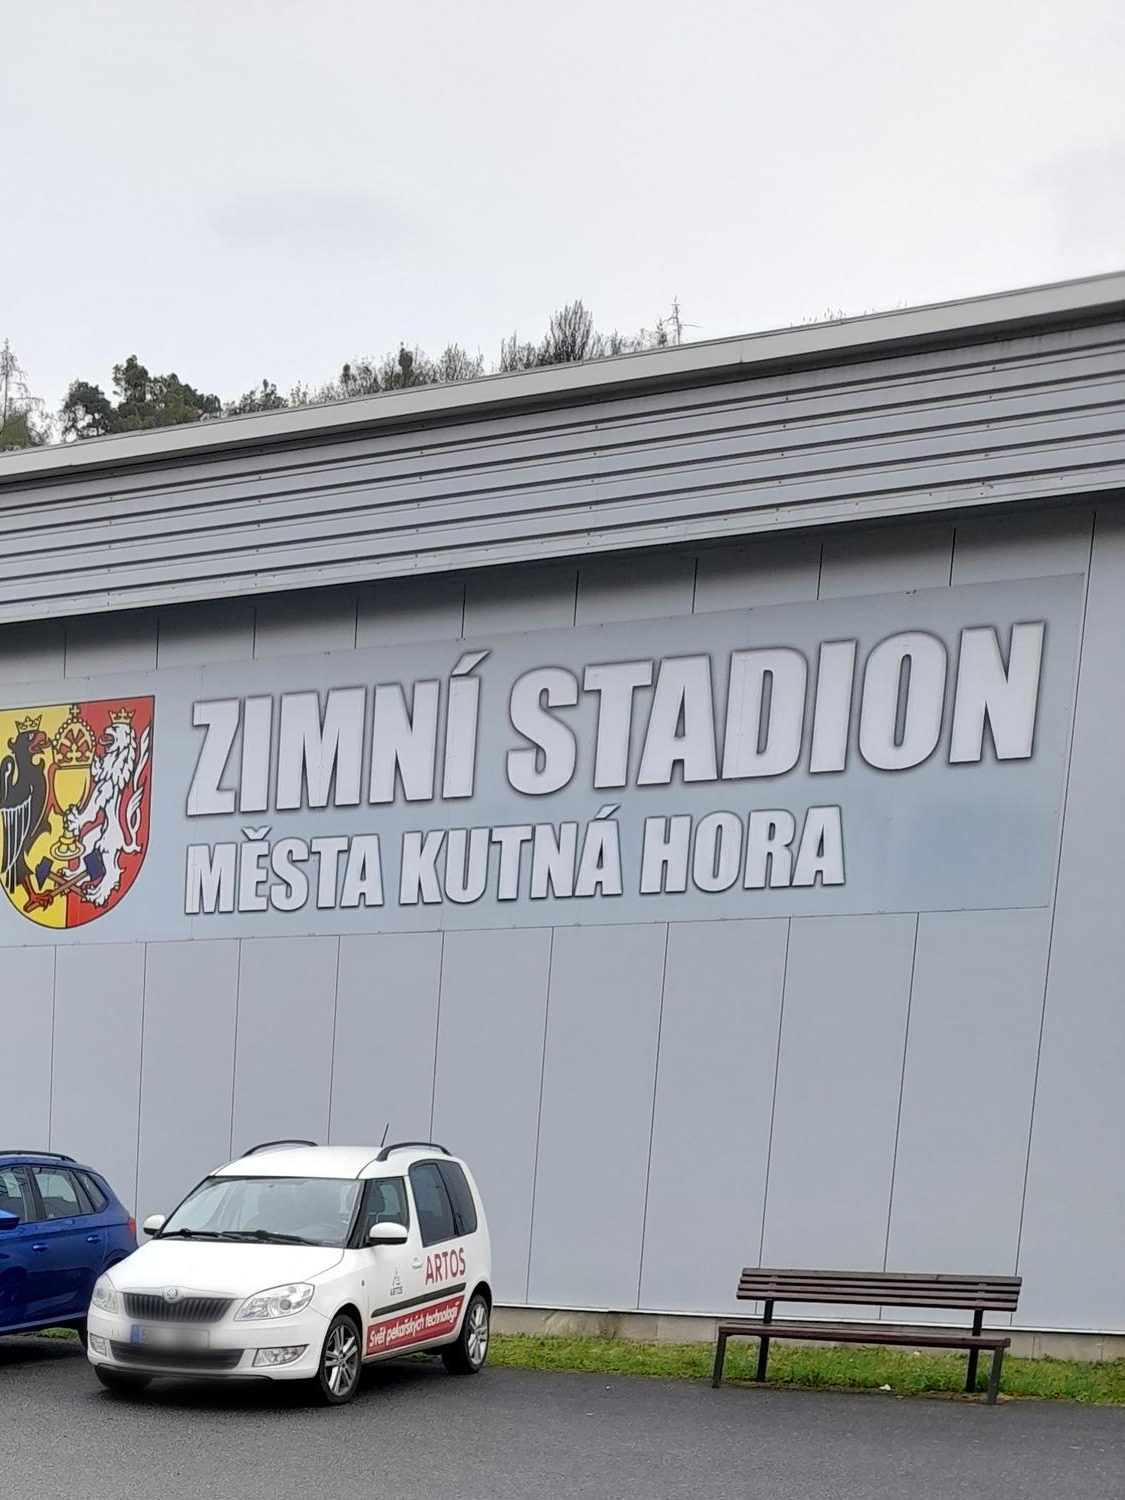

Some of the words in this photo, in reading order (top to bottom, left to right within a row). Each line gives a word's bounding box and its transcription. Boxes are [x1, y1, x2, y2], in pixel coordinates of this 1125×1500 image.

[185, 650, 491, 817] ZIMNÍ
[505, 619, 1047, 798] STADION
[182, 826, 384, 914] MĚSTA
[397, 803, 623, 904] KUTNÁ
[639, 803, 847, 895] HORA
[425, 1247, 466, 1285] ARTOS
[369, 1329, 386, 1347] Svět
[386, 1314, 425, 1345] pekařských
